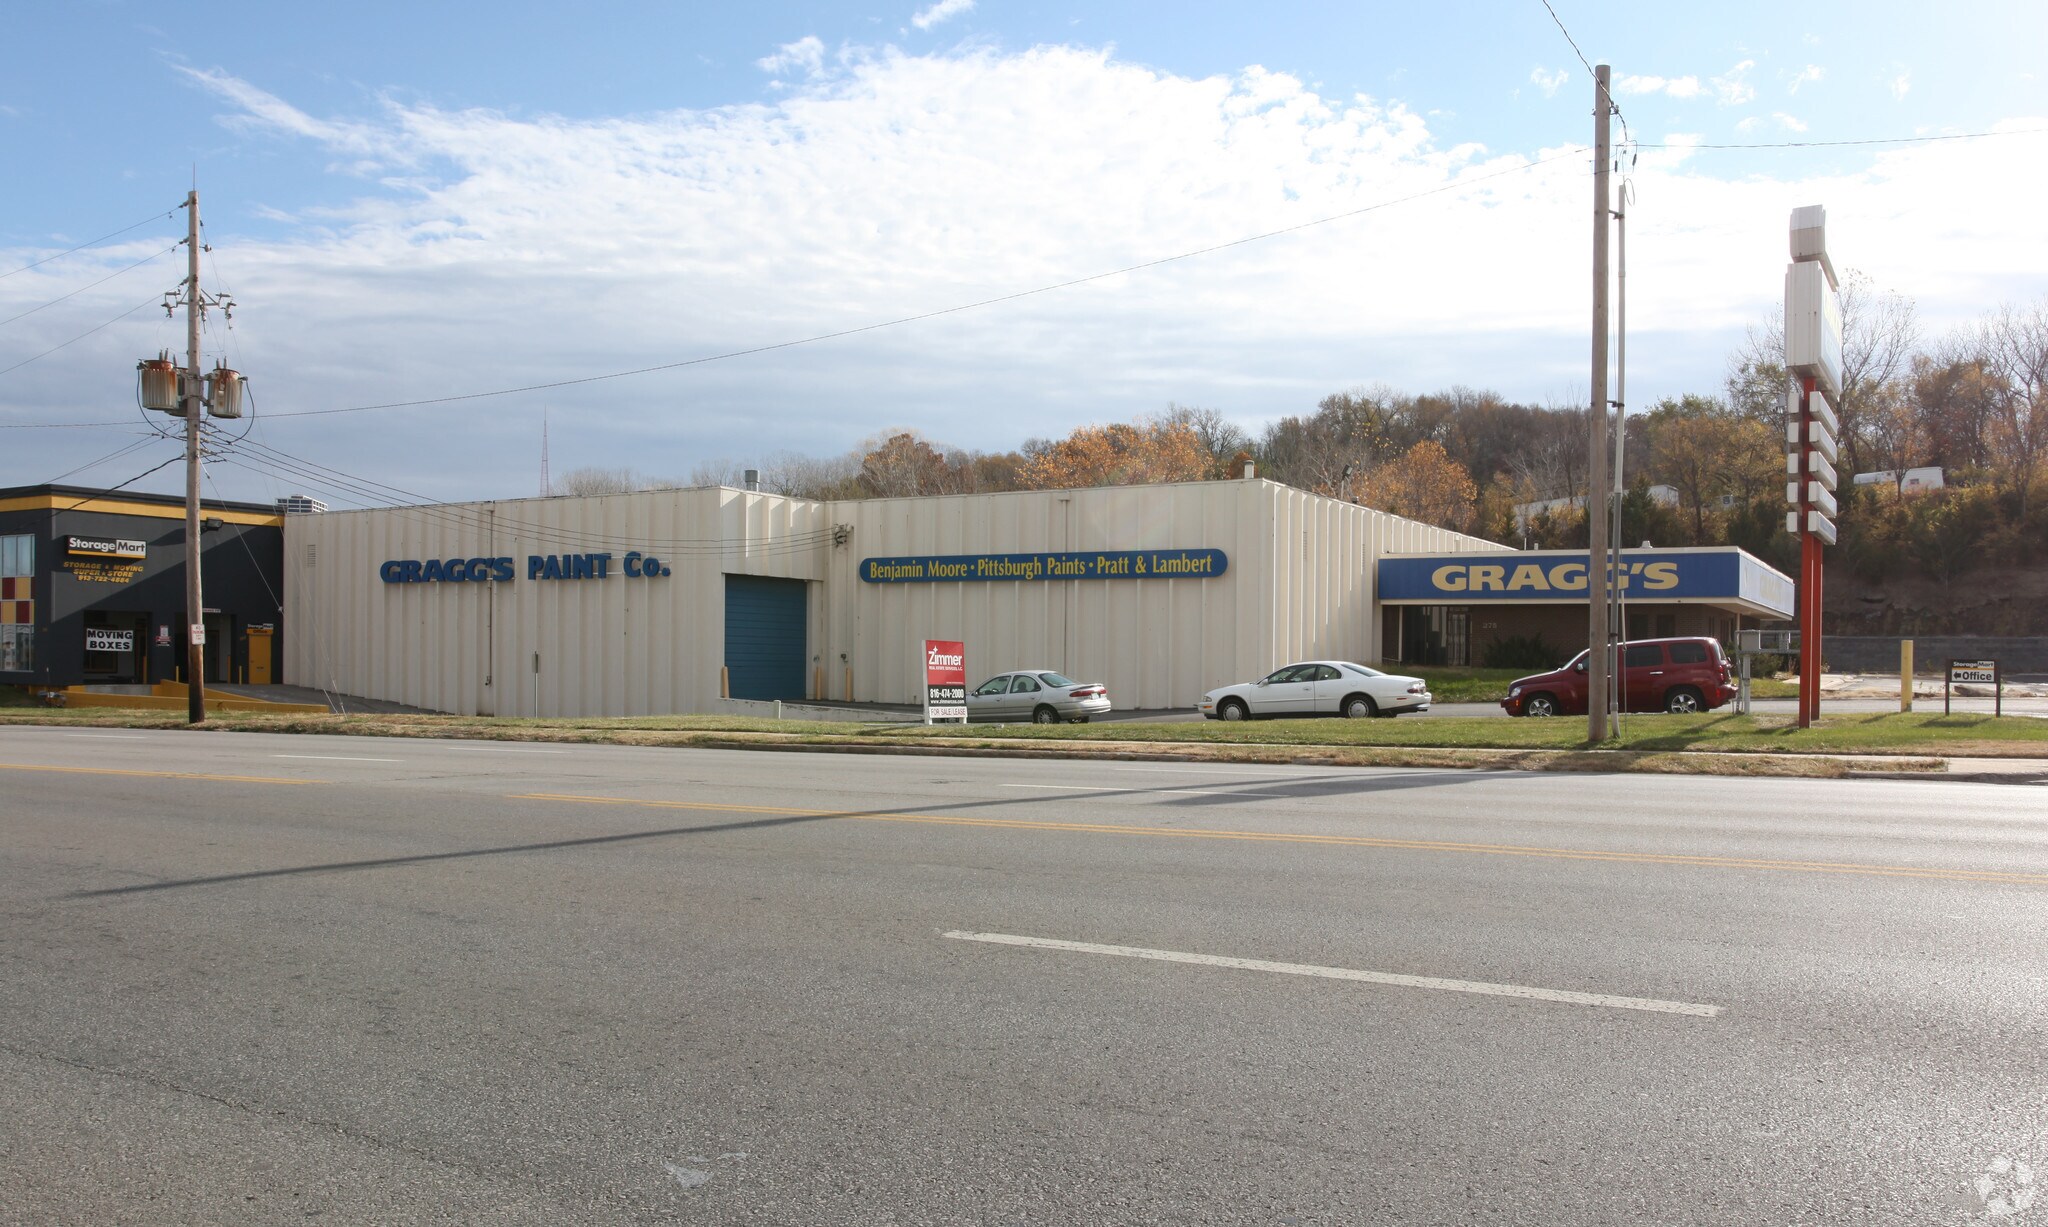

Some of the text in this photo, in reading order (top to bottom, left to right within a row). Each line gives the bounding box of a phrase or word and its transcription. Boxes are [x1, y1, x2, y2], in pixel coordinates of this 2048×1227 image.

[113, 564, 144, 572] MOVING
[380, 551, 671, 583] GRAGG'S PAINT Co.
[869, 553, 1212, 581] Benjamin Moore Pittsburgh Paints Pratt & Lambert
[73, 568, 134, 578] SUPER STORE
[87, 630, 133, 639] MOVING
[89, 640, 130, 650] BOXES
[928, 649, 963, 666] Zimmer
[1962, 671, 1992, 680] Office
[931, 708, 940, 716] FOR
